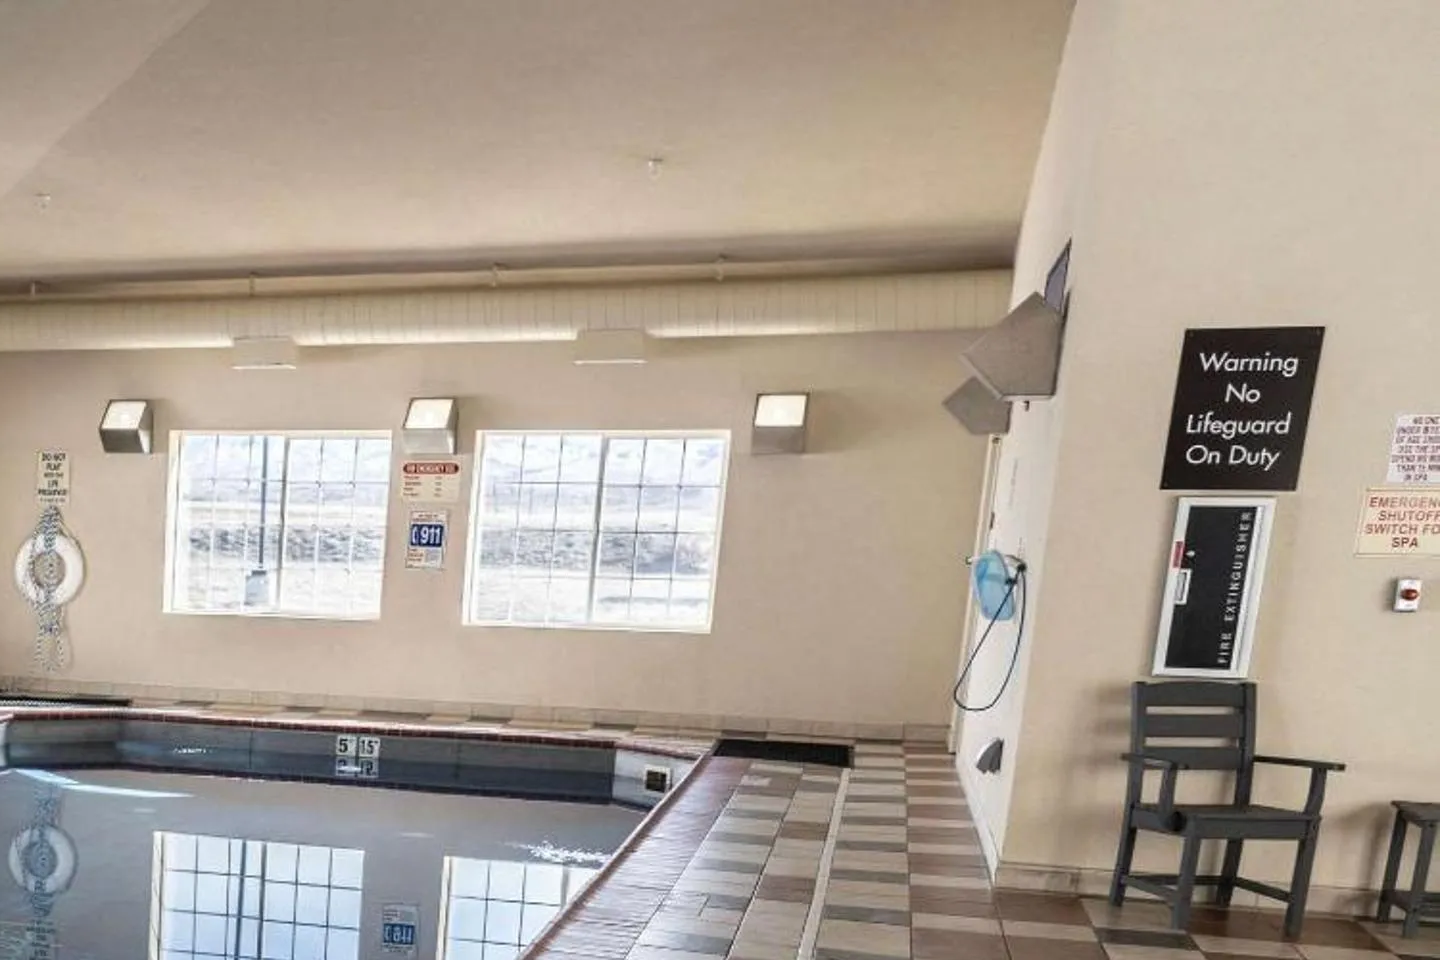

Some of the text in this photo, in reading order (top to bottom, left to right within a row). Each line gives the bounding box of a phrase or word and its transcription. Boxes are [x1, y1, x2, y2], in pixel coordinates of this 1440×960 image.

[1200, 351, 1299, 377] Warning
[1224, 383, 1261, 403] No
[1186, 411, 1292, 440] Lifeguard
[1186, 445, 1280, 471] On Duty
[1369, 496, 1440, 508] EMERGEN
[421, 525, 441, 545] 911
[1365, 523, 1419, 535] SWITCH
[1391, 537, 1419, 548] SPA
[1216, 511, 1253, 665] FIRE EXTINGUISHER
[338, 738, 348, 753] 5
